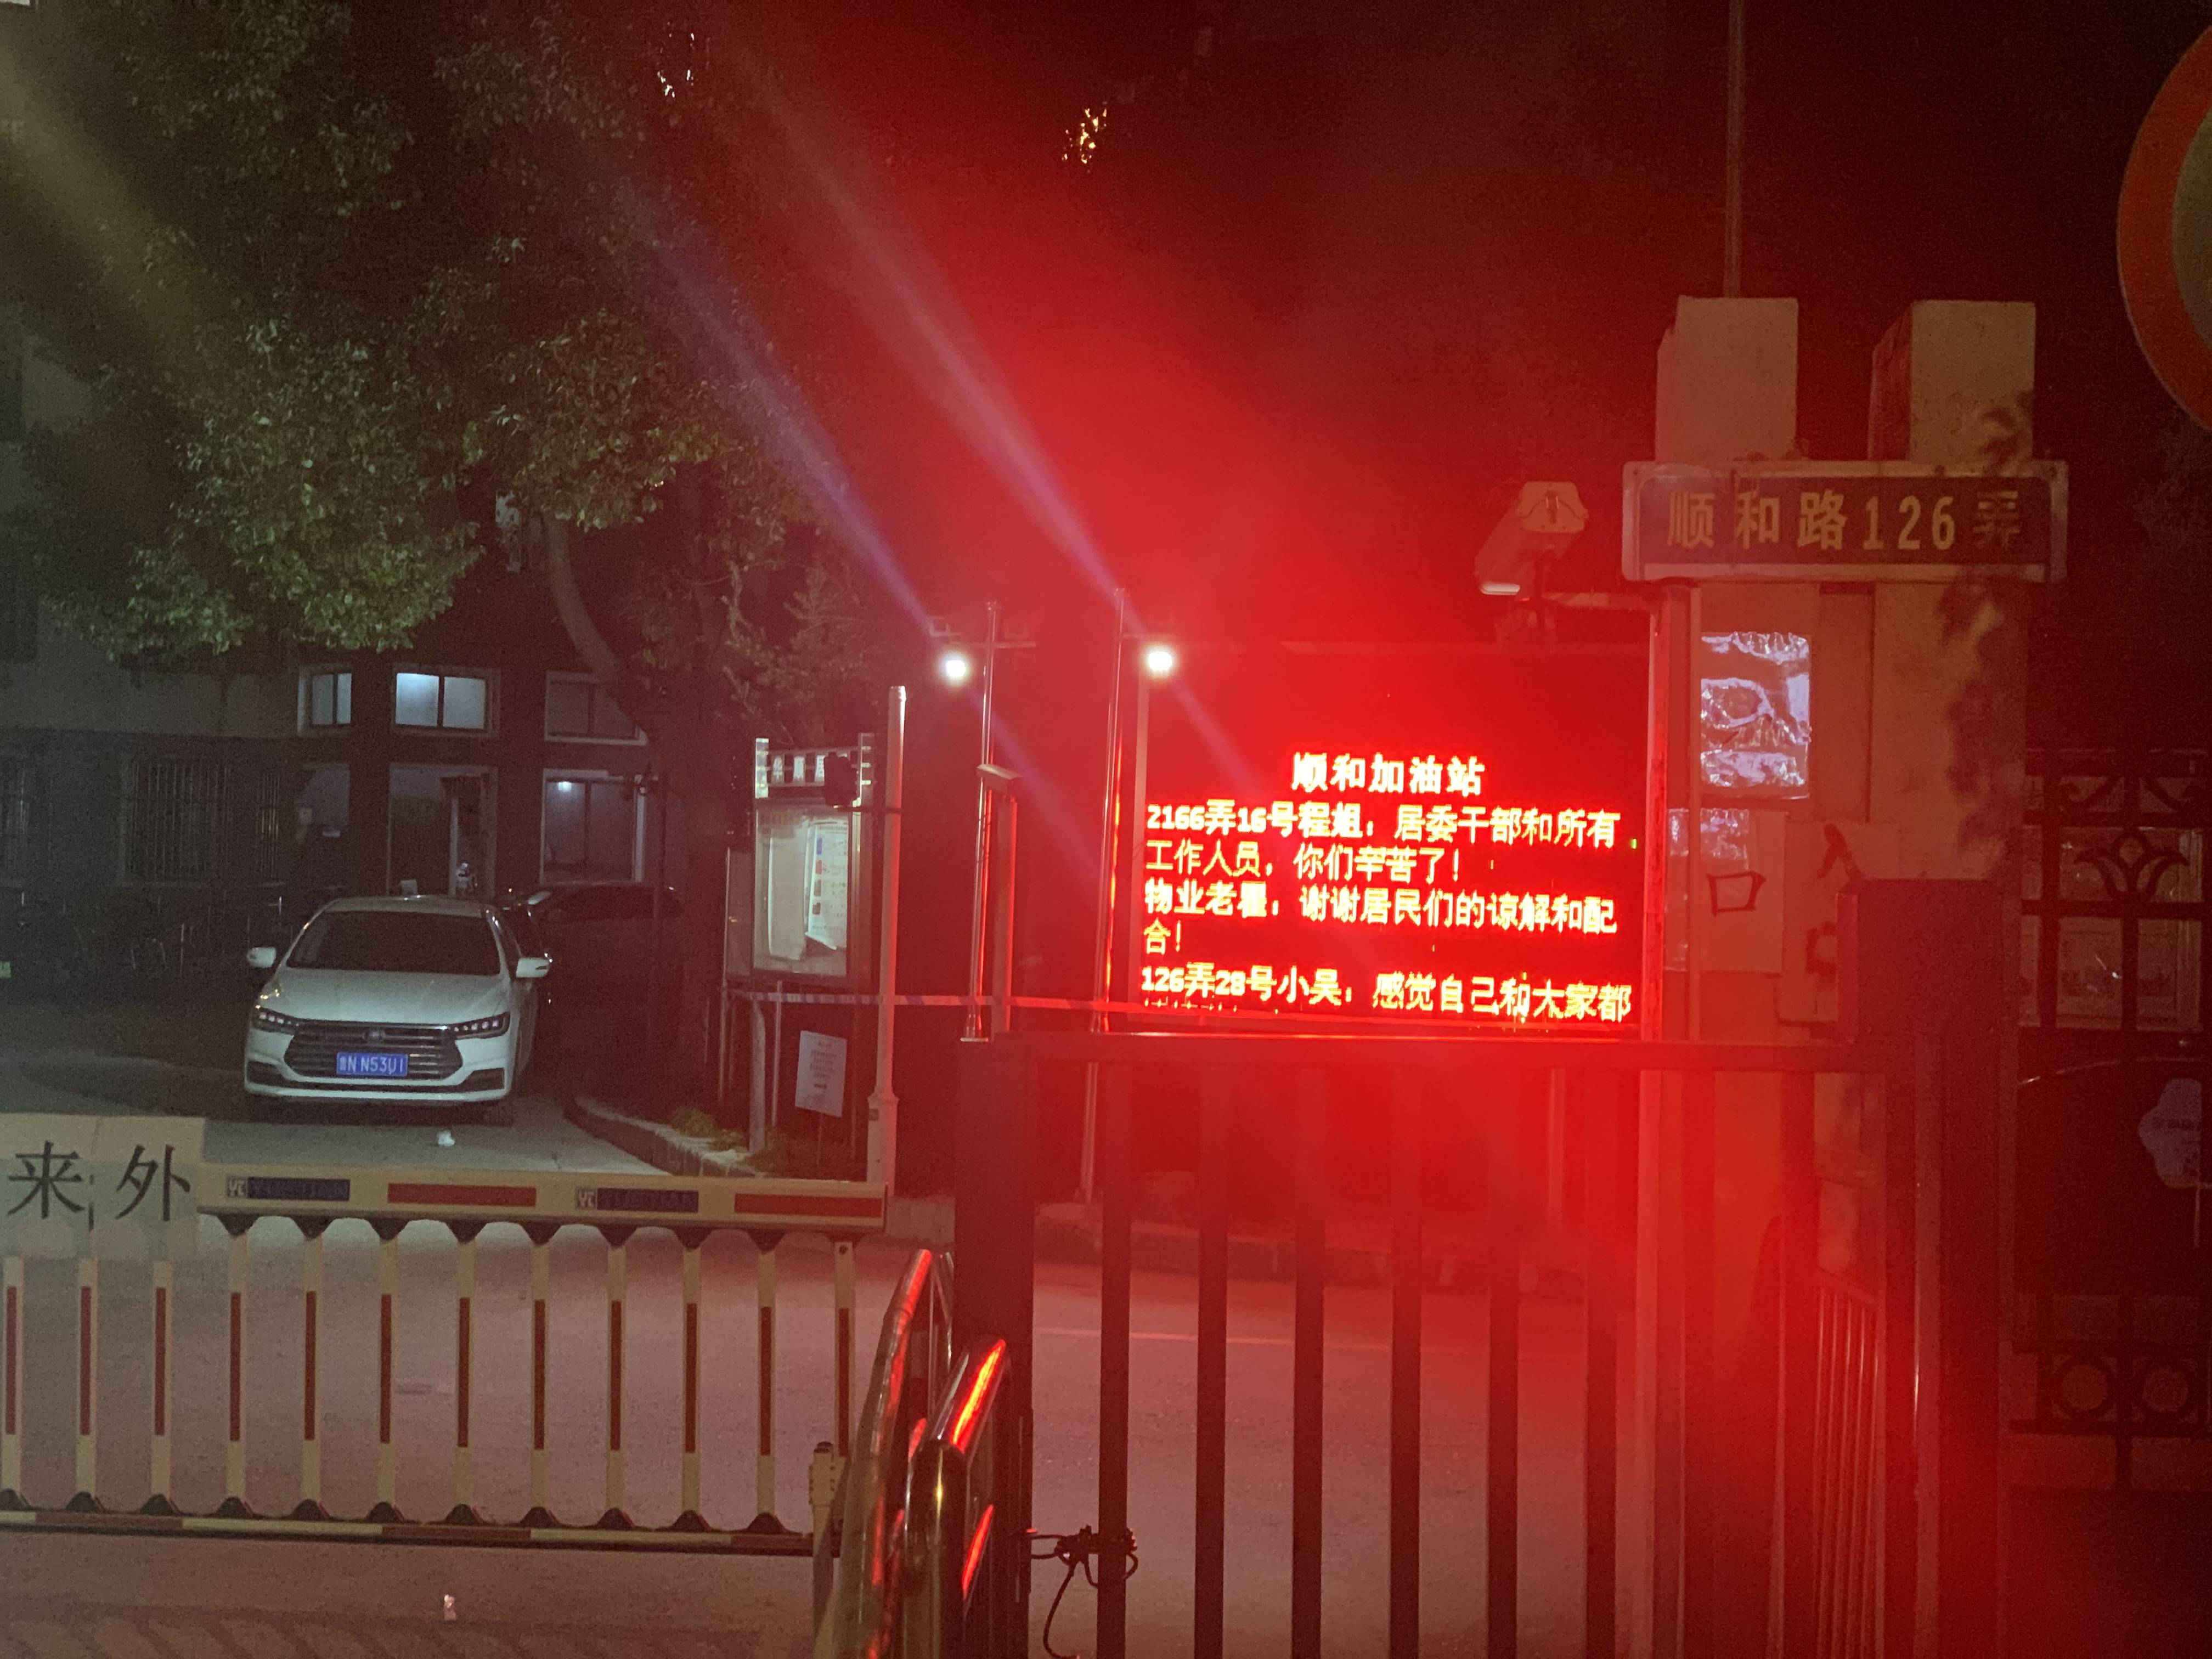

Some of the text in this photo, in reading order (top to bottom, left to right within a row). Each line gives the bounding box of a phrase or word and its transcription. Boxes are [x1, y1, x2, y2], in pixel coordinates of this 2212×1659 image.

[1667, 489, 2021, 550] 顺和路126弄
[1291, 752, 1485, 797] 顺和加油站
[1145, 839, 1459, 884] 工作人员，你们辛苦了！
